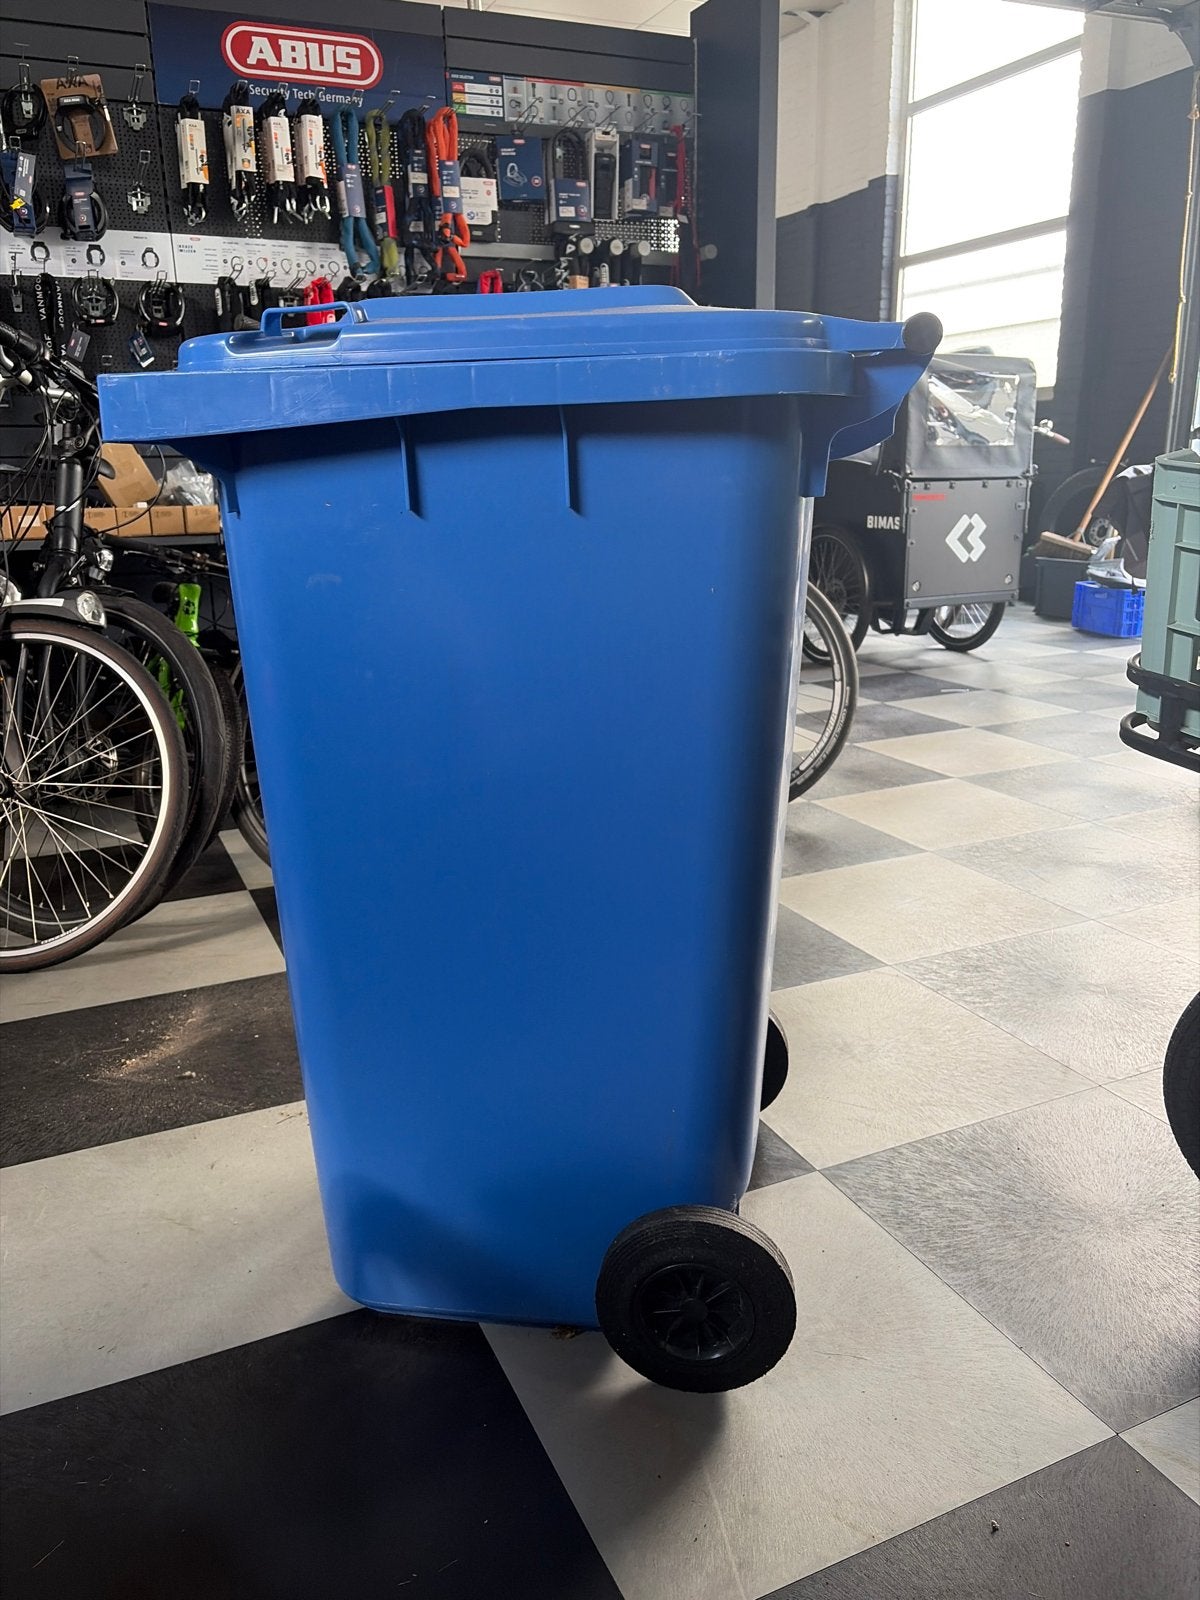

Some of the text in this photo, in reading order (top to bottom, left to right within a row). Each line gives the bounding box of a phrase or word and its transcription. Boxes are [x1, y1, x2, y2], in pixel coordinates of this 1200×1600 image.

[246, 36, 362, 76] ABUS
[56, 78, 89, 90] AXA
[292, 88, 316, 101] Tech
[318, 91, 364, 108] Germany
[34, 273, 47, 321] VANMOO
[866, 514, 901, 530] BIMAS
